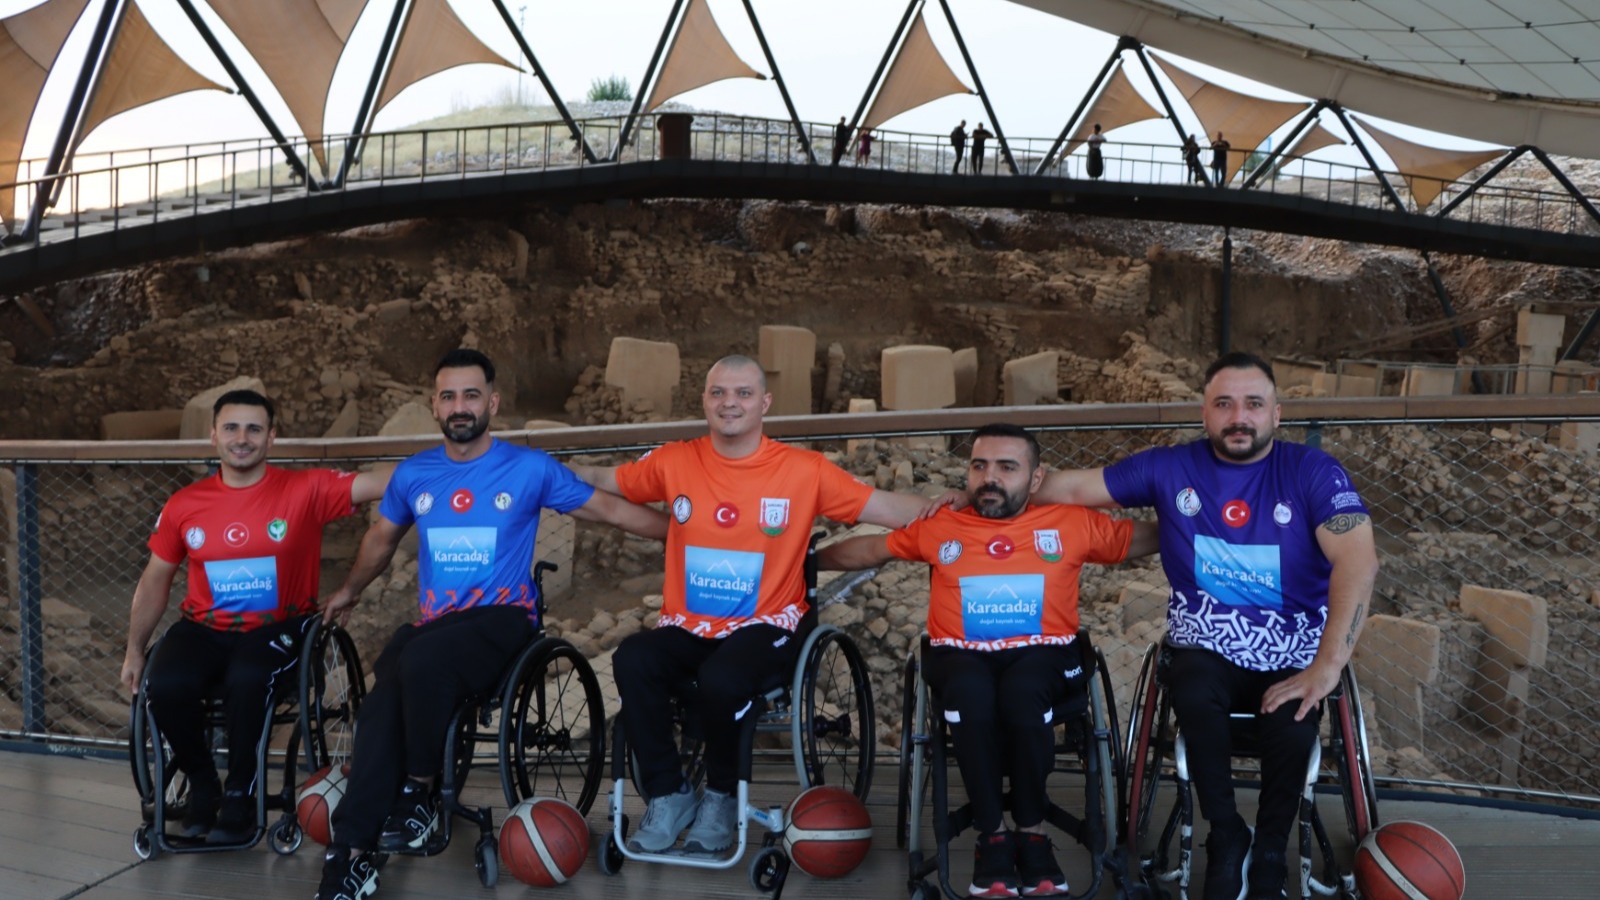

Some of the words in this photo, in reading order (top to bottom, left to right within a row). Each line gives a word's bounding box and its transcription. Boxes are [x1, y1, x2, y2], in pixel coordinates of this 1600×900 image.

[434, 549, 489, 565] Karacadağ
[690, 571, 755, 595] Karacadağ
[1202, 560, 1275, 589] Karacadağ
[213, 576, 272, 592] Karacadağ
[967, 599, 1037, 616] Karacadağ
